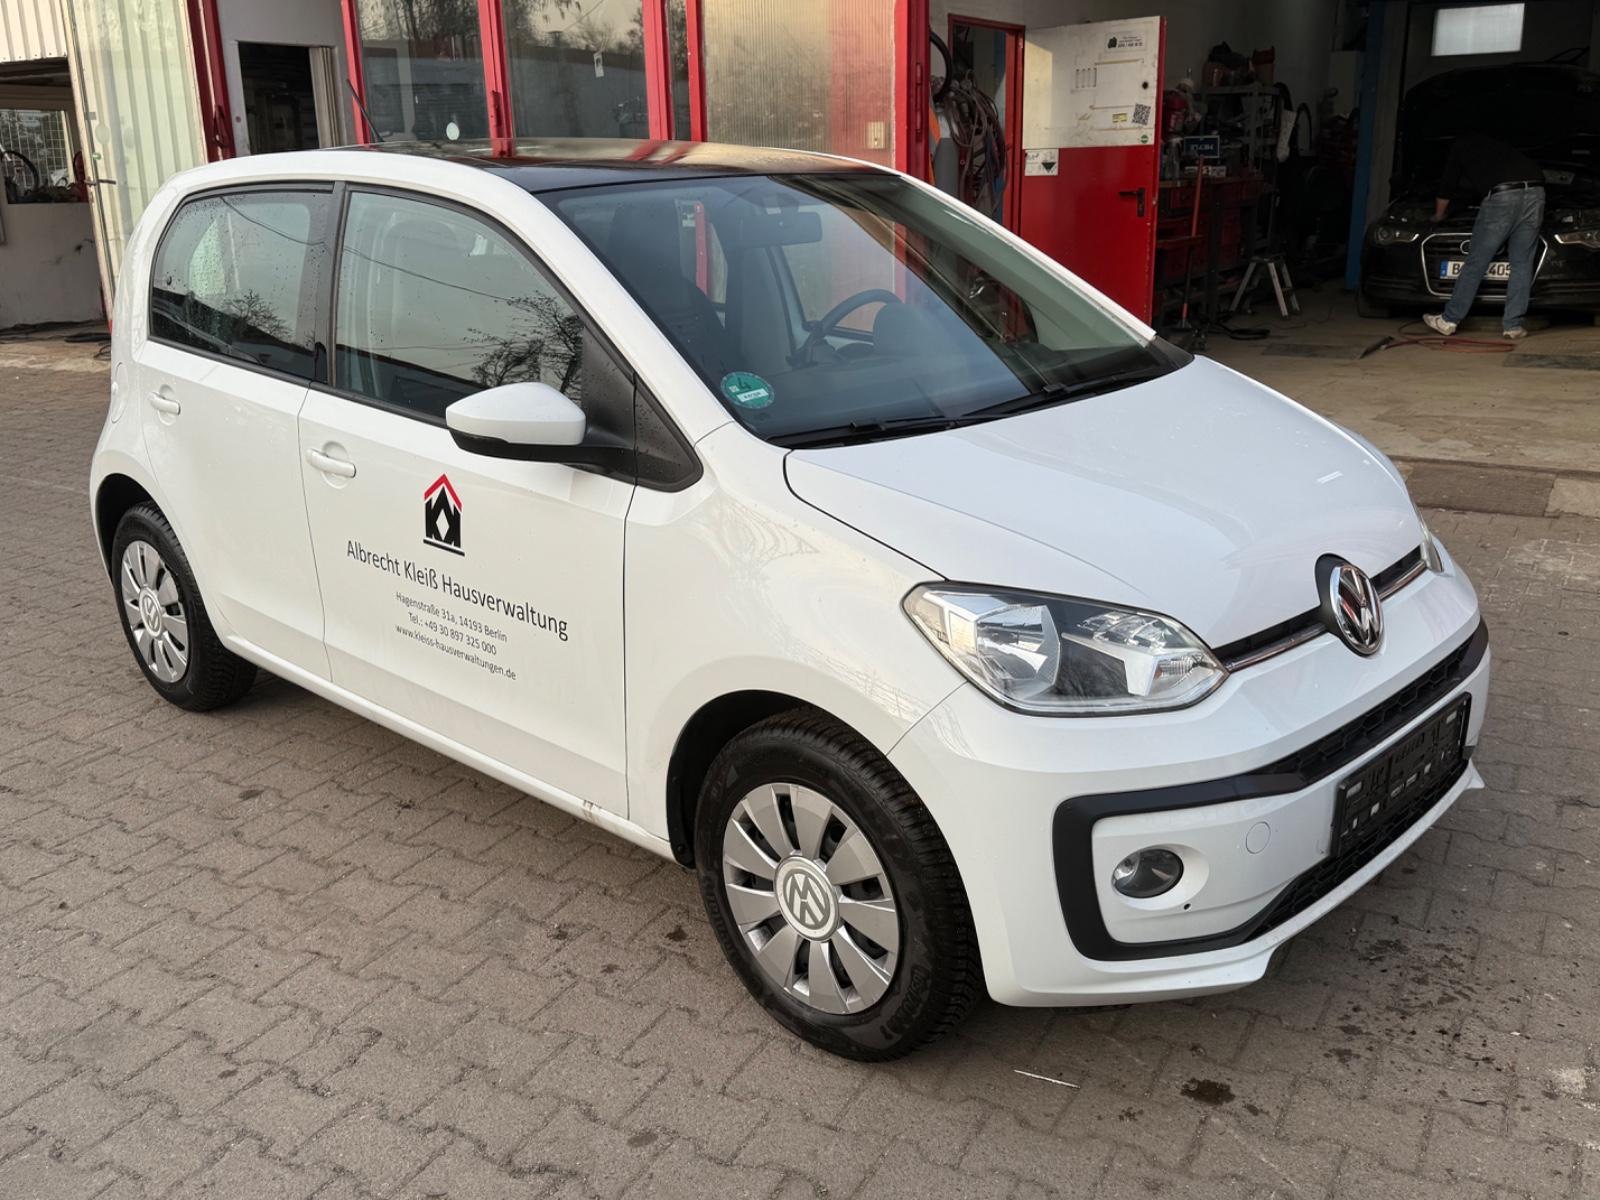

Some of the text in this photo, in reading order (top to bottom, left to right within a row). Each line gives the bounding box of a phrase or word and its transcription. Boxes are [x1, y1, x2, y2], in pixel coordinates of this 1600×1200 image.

[347, 540, 569, 642] Albrecht Kleiß Hausverwaltung
[396, 592, 508, 643] Hagenstraße 31a, 14193 Berlin
[395, 625, 517, 680] www.kleiss-hausverwaltungen.de
[408, 612, 497, 656] Tel.: +49 30 897 325 000
